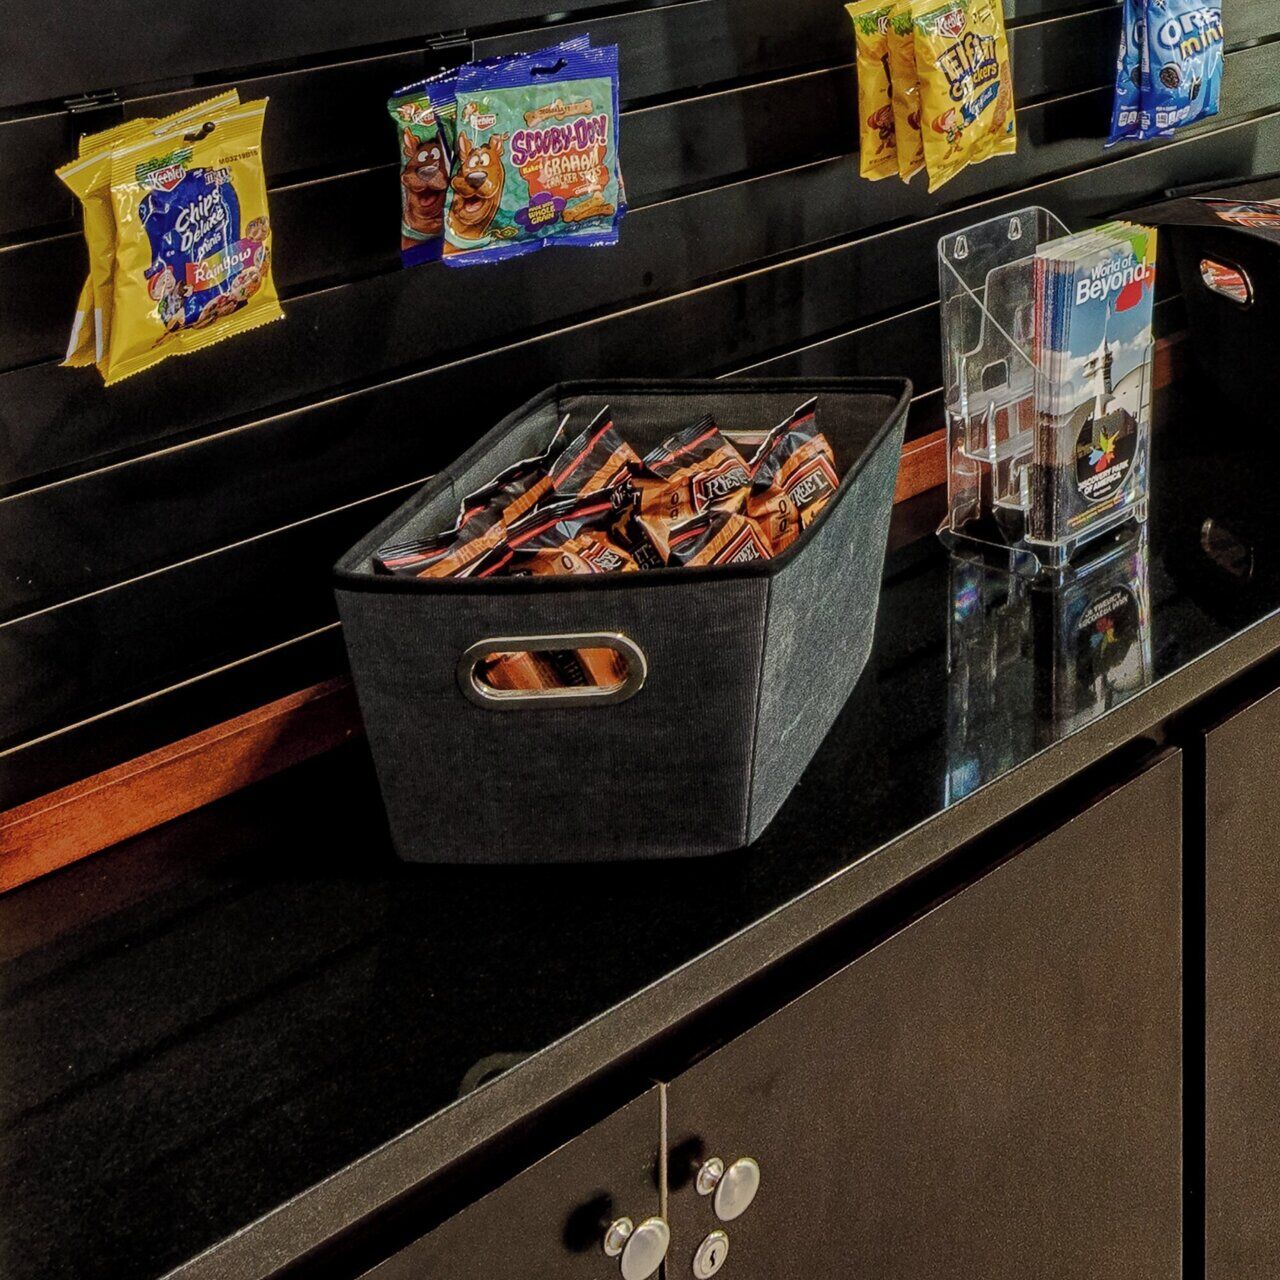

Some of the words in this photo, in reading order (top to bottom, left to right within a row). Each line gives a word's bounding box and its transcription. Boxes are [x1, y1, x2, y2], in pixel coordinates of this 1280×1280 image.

[511, 115, 608, 166] SCOOBY-DOO!
[543, 152, 599, 176] GRAHAM
[176, 188, 221, 232] Chips
[180, 205, 226, 253] Deluxe
[194, 247, 252, 284] Rainbow
[1075, 256, 1150, 306] Beyond.
[1091, 259, 1121, 281] World
[1122, 253, 1133, 269] of
